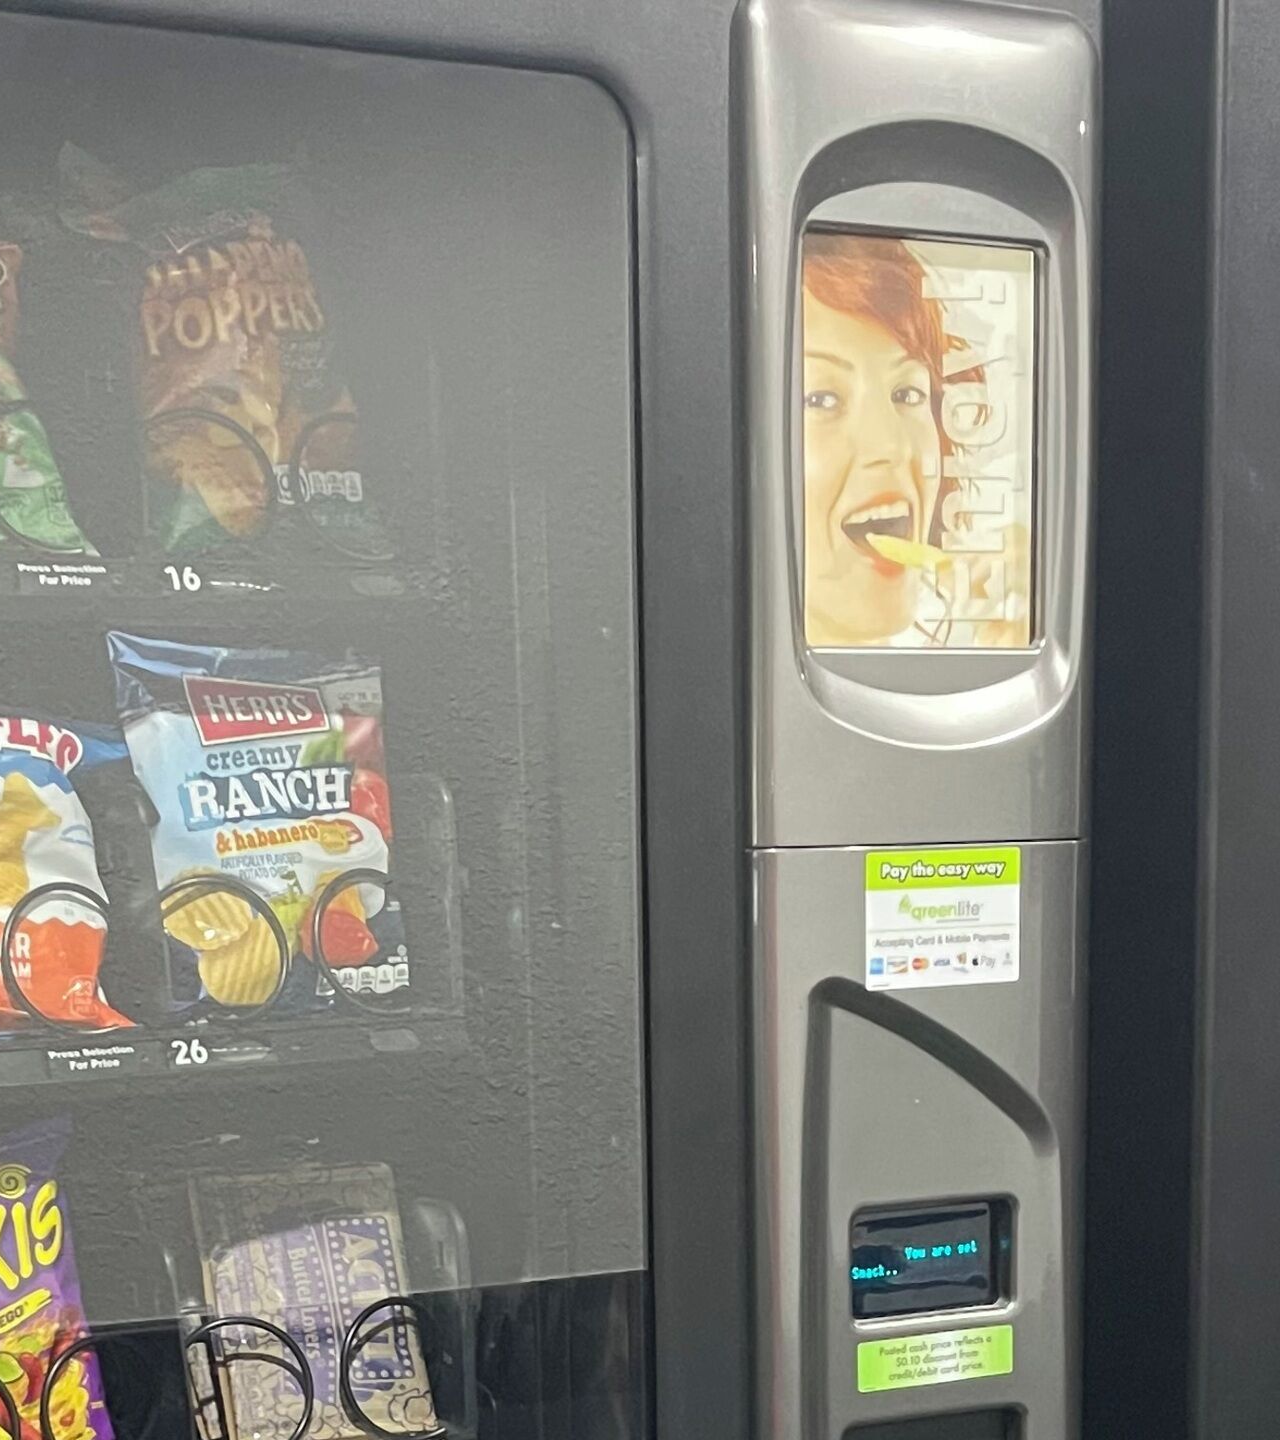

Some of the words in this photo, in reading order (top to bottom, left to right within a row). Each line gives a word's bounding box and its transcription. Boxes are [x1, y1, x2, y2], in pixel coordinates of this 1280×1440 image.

[164, 565, 202, 592] 16
[206, 742, 303, 771] creamy
[185, 767, 352, 822] RANCH
[234, 822, 319, 852] habanero
[880, 862, 909, 882] Pay
[911, 859, 935, 878] the
[937, 862, 971, 880] easy
[974, 861, 1007, 879] way
[172, 1041, 208, 1065] 26
